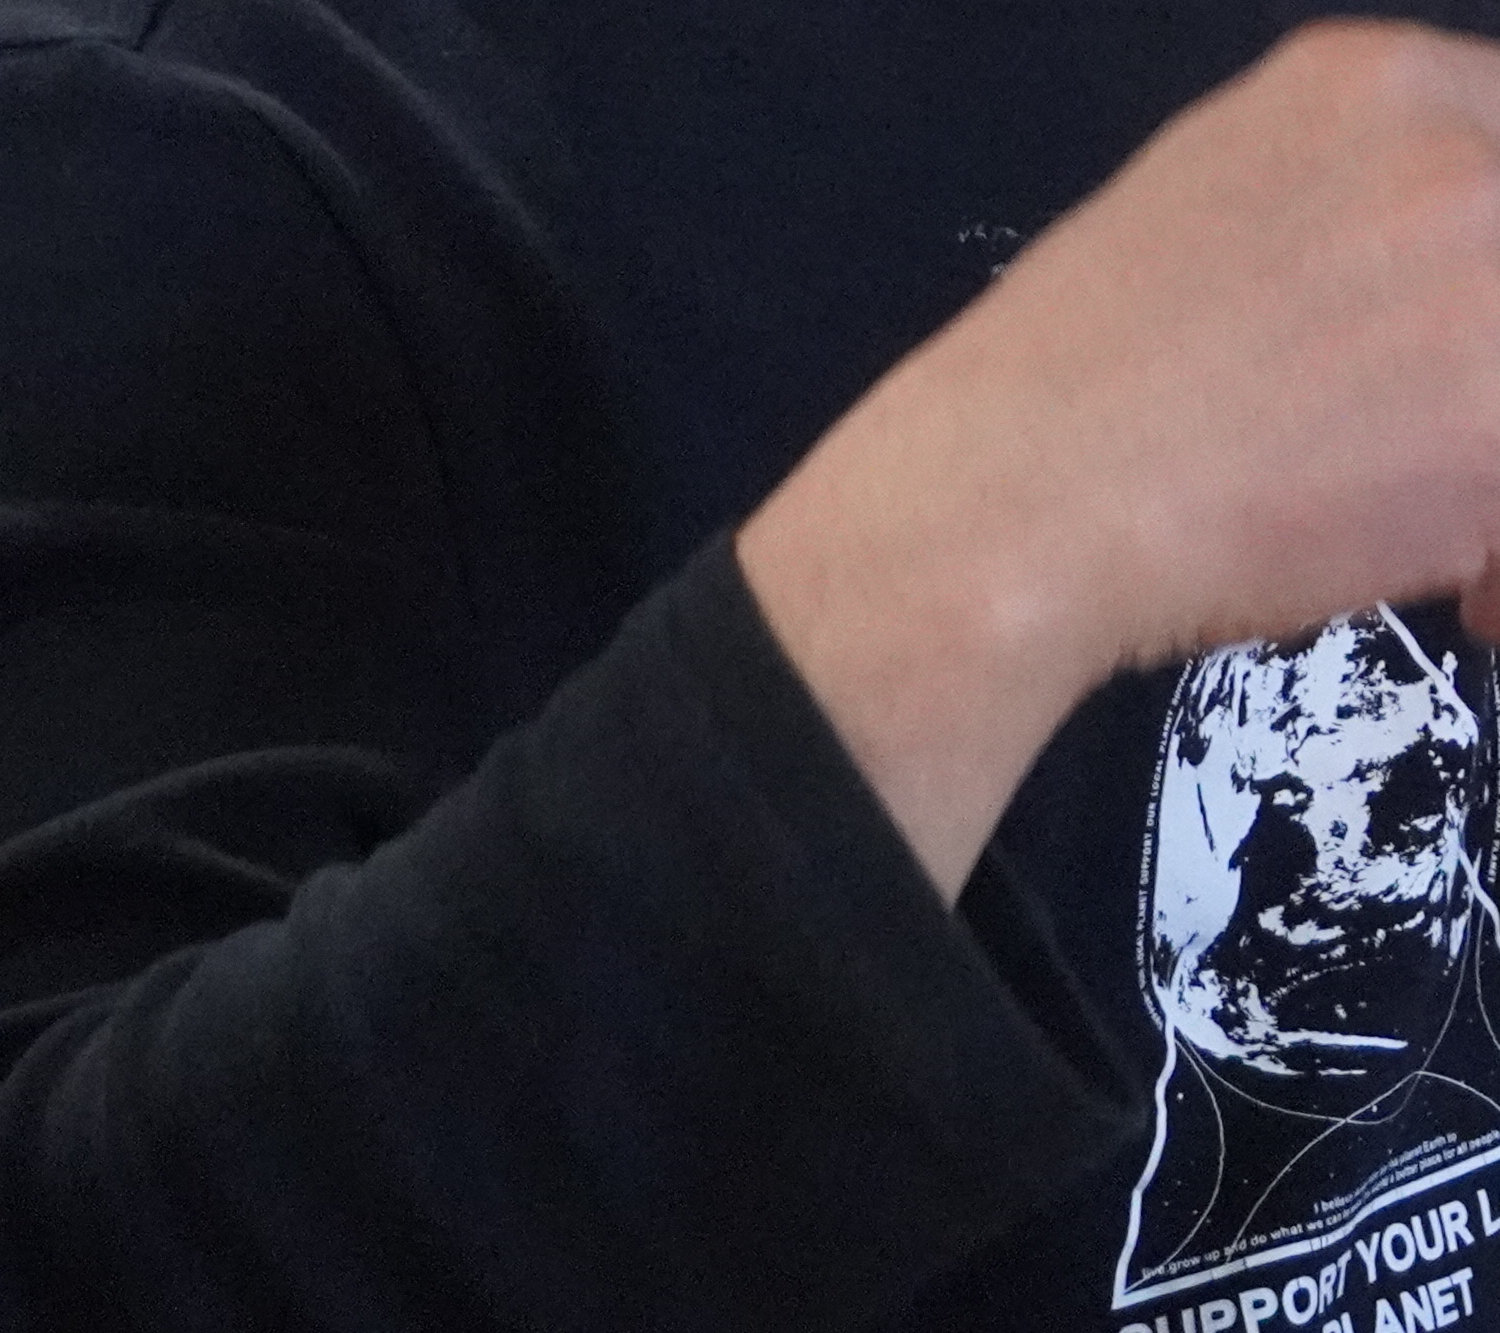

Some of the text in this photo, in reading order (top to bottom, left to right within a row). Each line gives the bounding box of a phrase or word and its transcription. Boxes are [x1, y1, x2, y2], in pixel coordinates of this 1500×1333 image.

[1118, 1249, 1352, 1333] PPORT
[1355, 1200, 1476, 1284] YOUR
[1251, 1234, 1267, 1247] do
[1270, 1223, 1303, 1240] what
[1321, 1267, 1474, 1333] ANET
